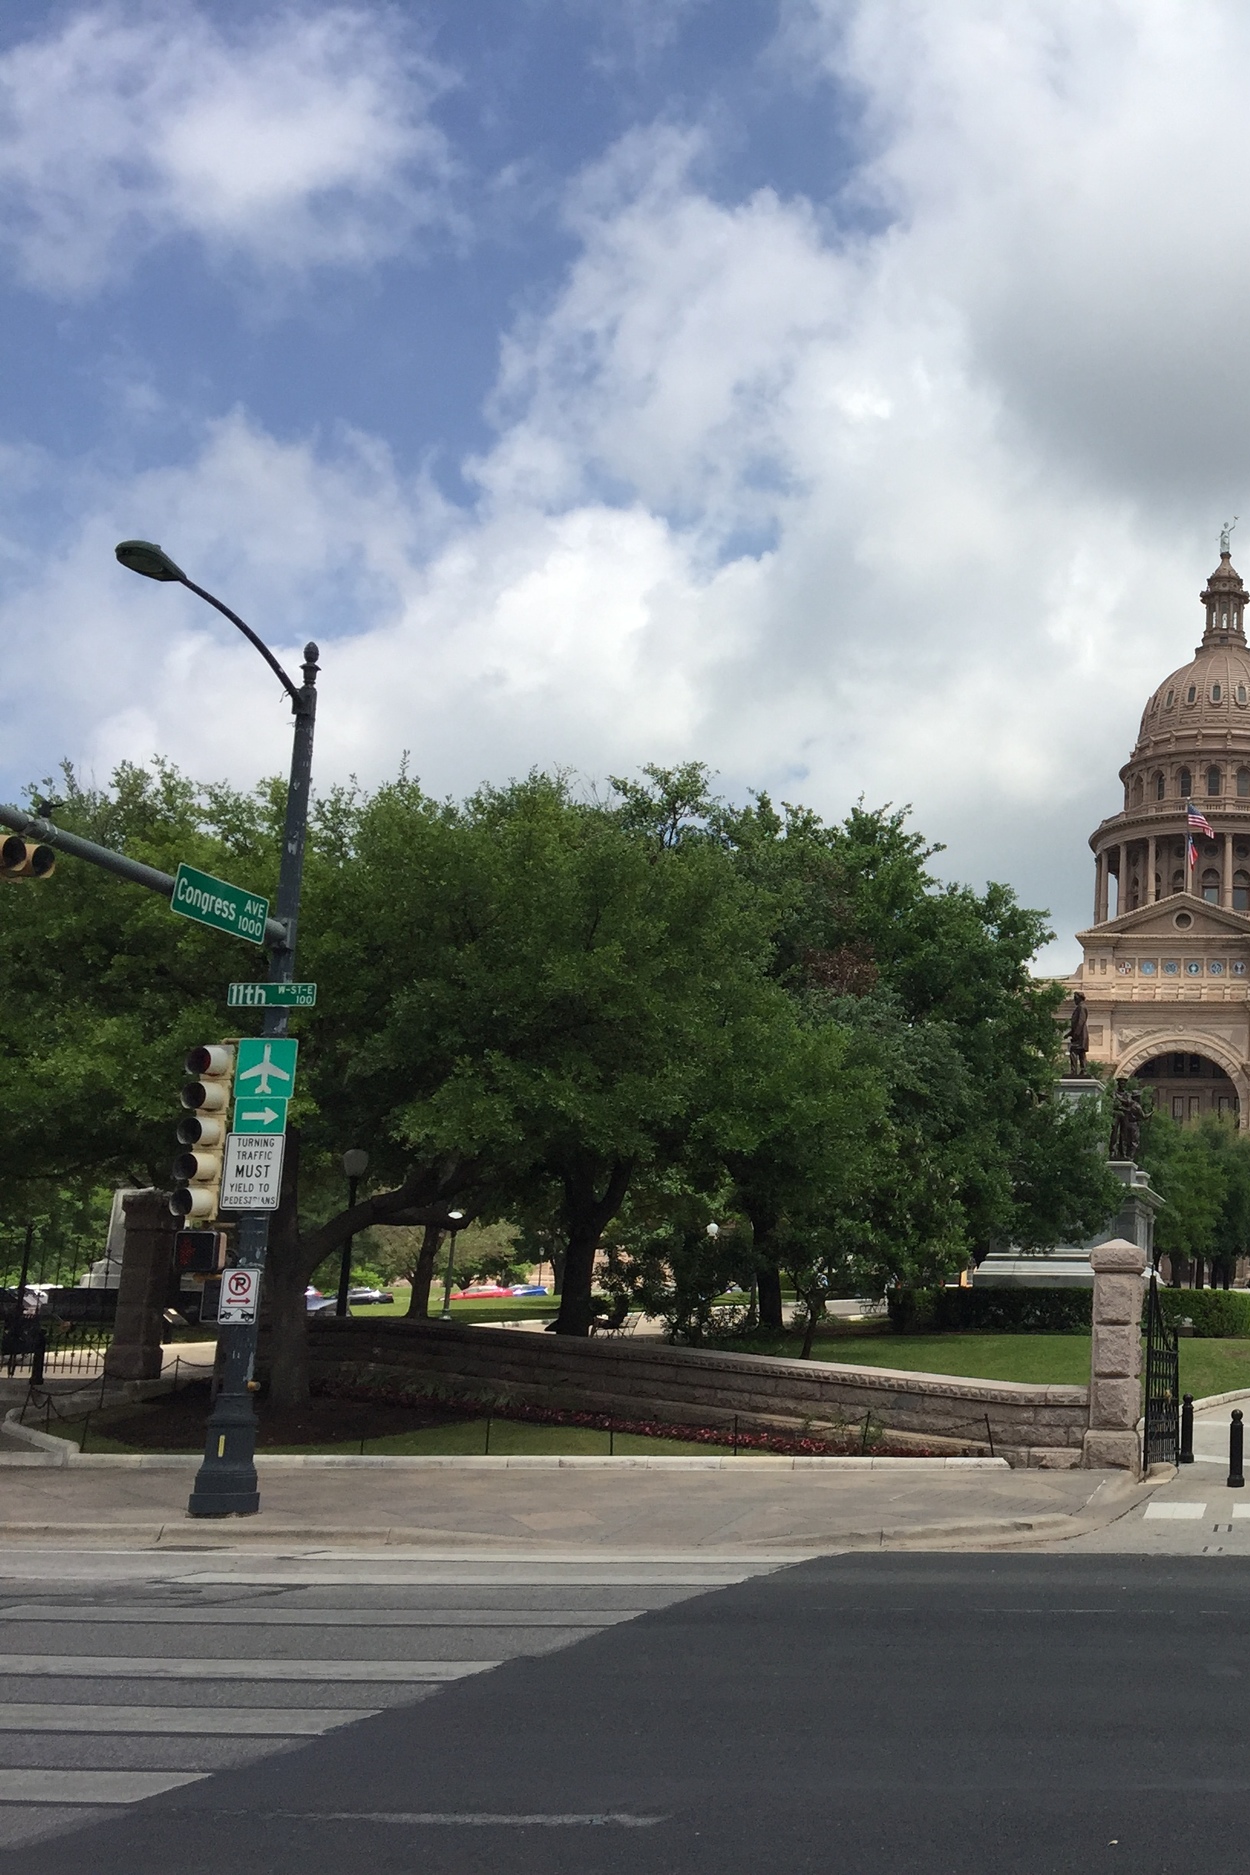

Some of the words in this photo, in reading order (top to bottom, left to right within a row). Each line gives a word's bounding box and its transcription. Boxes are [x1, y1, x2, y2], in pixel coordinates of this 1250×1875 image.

[177, 877, 237, 921] Congress
[244, 899, 265, 919] AVE
[238, 915, 263, 937] 1000
[231, 984, 266, 1005] 11th
[296, 995, 313, 1005] 100
[237, 1137, 275, 1148] TURNING
[237, 1150, 273, 1161] TRAFFIC
[235, 1164, 271, 1178] MUST
[229, 1183, 254, 1193] YIELD
[258, 1183, 270, 1193] TO
